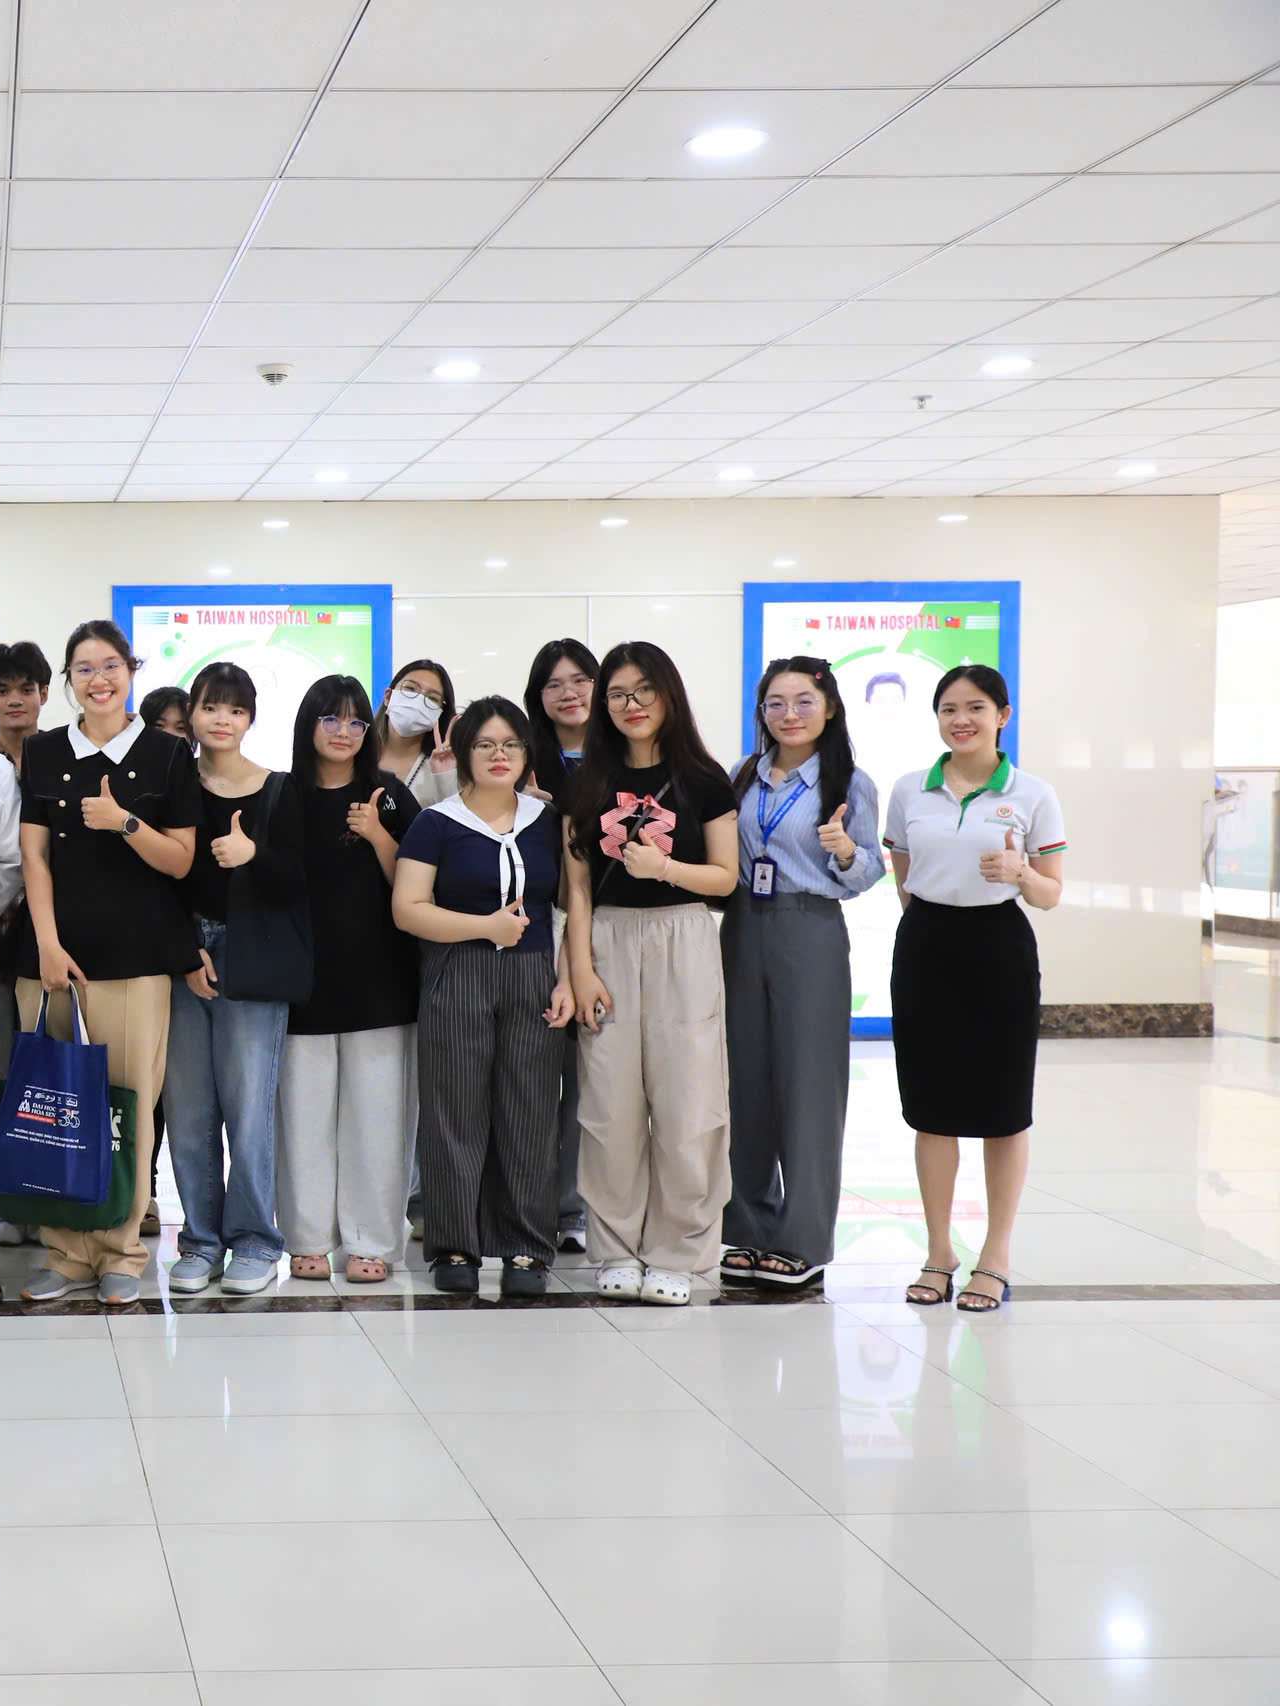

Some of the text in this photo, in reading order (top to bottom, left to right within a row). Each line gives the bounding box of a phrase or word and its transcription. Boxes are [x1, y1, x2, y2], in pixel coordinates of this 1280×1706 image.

[196, 610, 310, 625] TAIWAN HOSPITAL
[827, 615, 941, 630] TAIWAN HOSPITAL
[58, 1108, 80, 1129] 35
